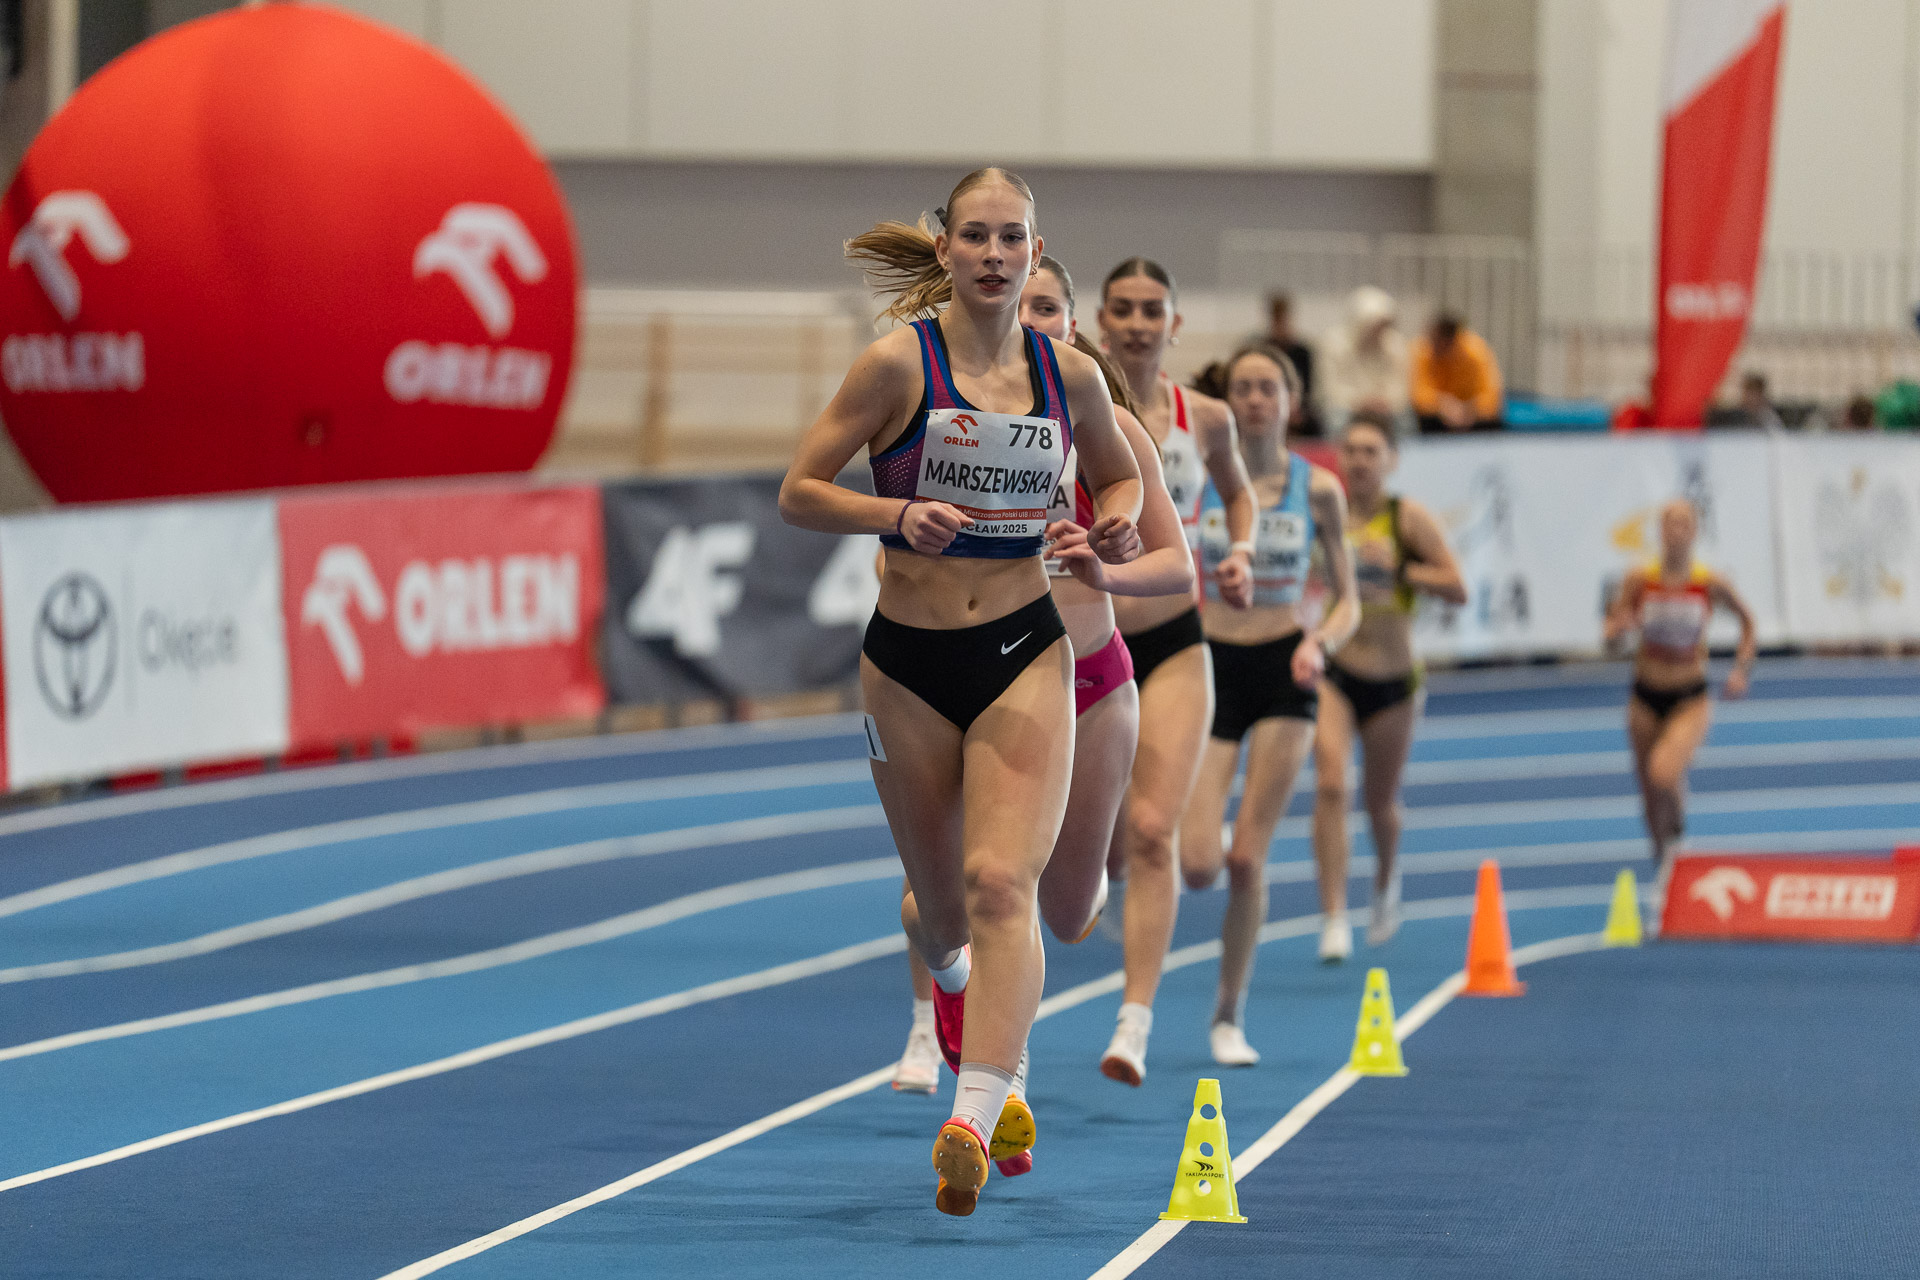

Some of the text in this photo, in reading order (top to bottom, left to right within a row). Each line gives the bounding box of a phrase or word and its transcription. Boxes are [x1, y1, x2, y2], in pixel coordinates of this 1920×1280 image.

[382, 340, 553, 411] ORLEN
[943, 435, 979, 448] ORLEN
[1009, 423, 1053, 450] 778
[924, 457, 1053, 494] MARSZEWSKA
[1002, 510, 1018, 518] Polski
[1032, 510, 1044, 518] U20
[1002, 523, 1028, 533] 2025
[627, 519, 757, 656] 4F
[395, 553, 580, 658] ORLEN
